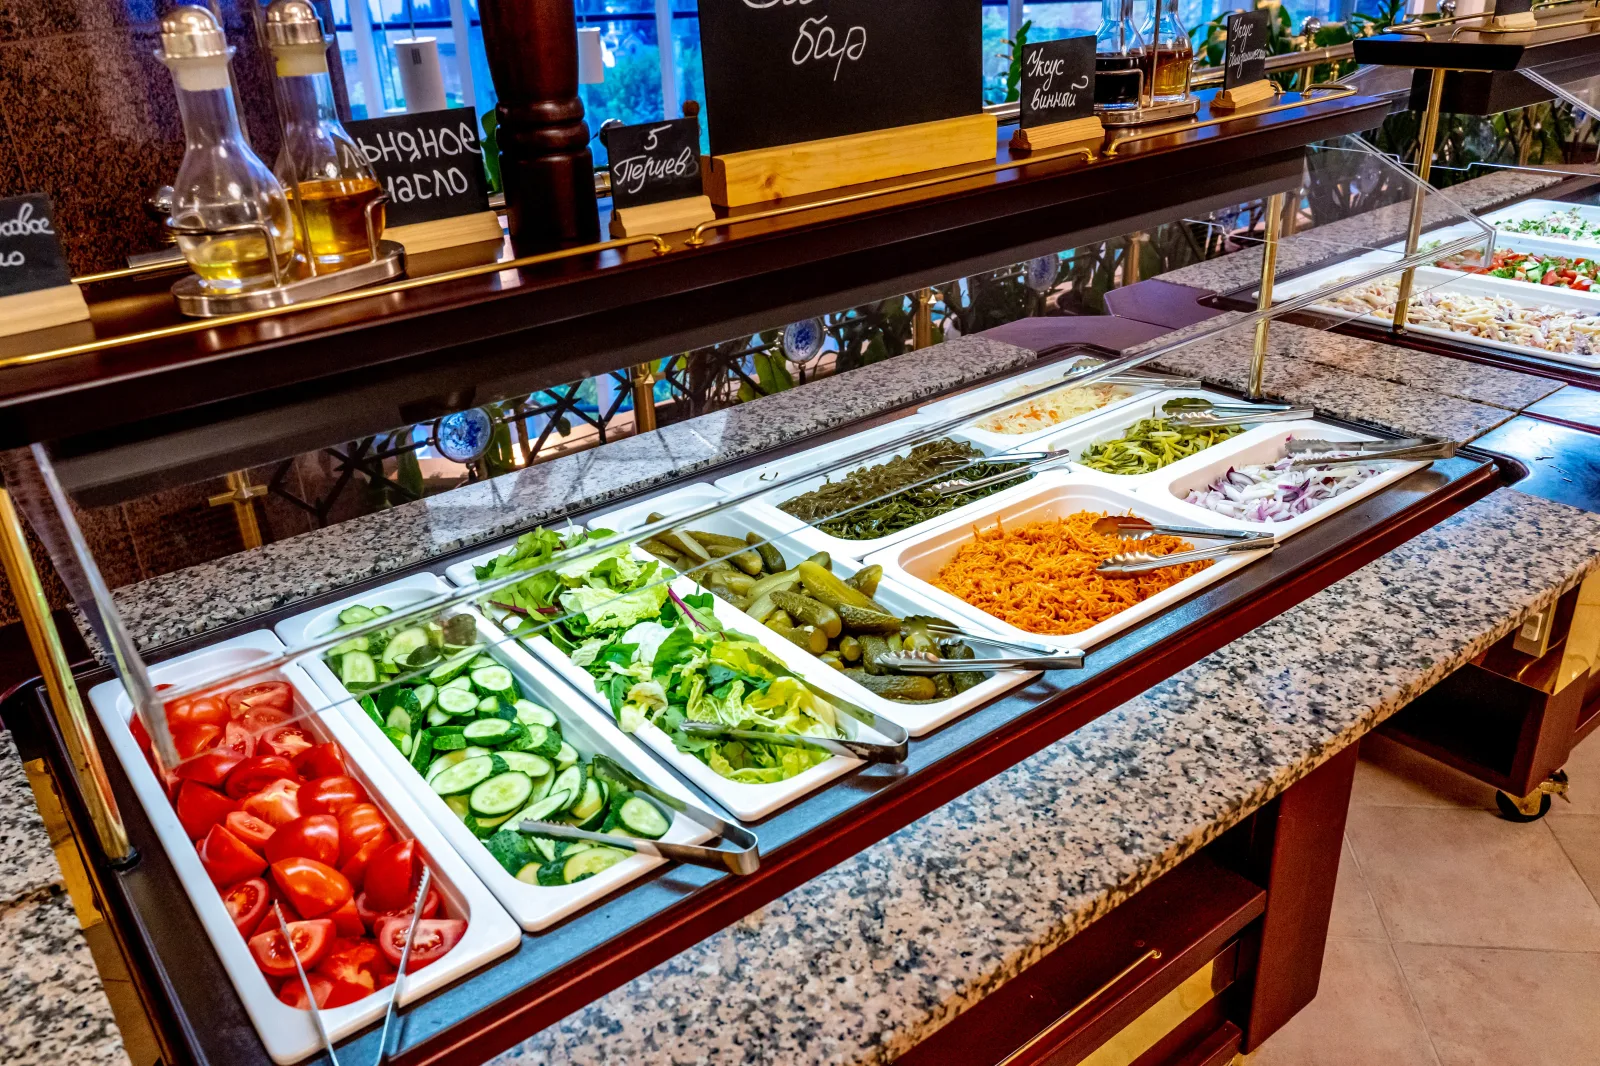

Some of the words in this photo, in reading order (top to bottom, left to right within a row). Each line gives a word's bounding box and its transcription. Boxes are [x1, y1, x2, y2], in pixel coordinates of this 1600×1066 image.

[792, 15, 866, 81] бар
[1027, 48, 1064, 91] Уксус
[644, 124, 673, 150] 5
[614, 146, 691, 194] Перцев
